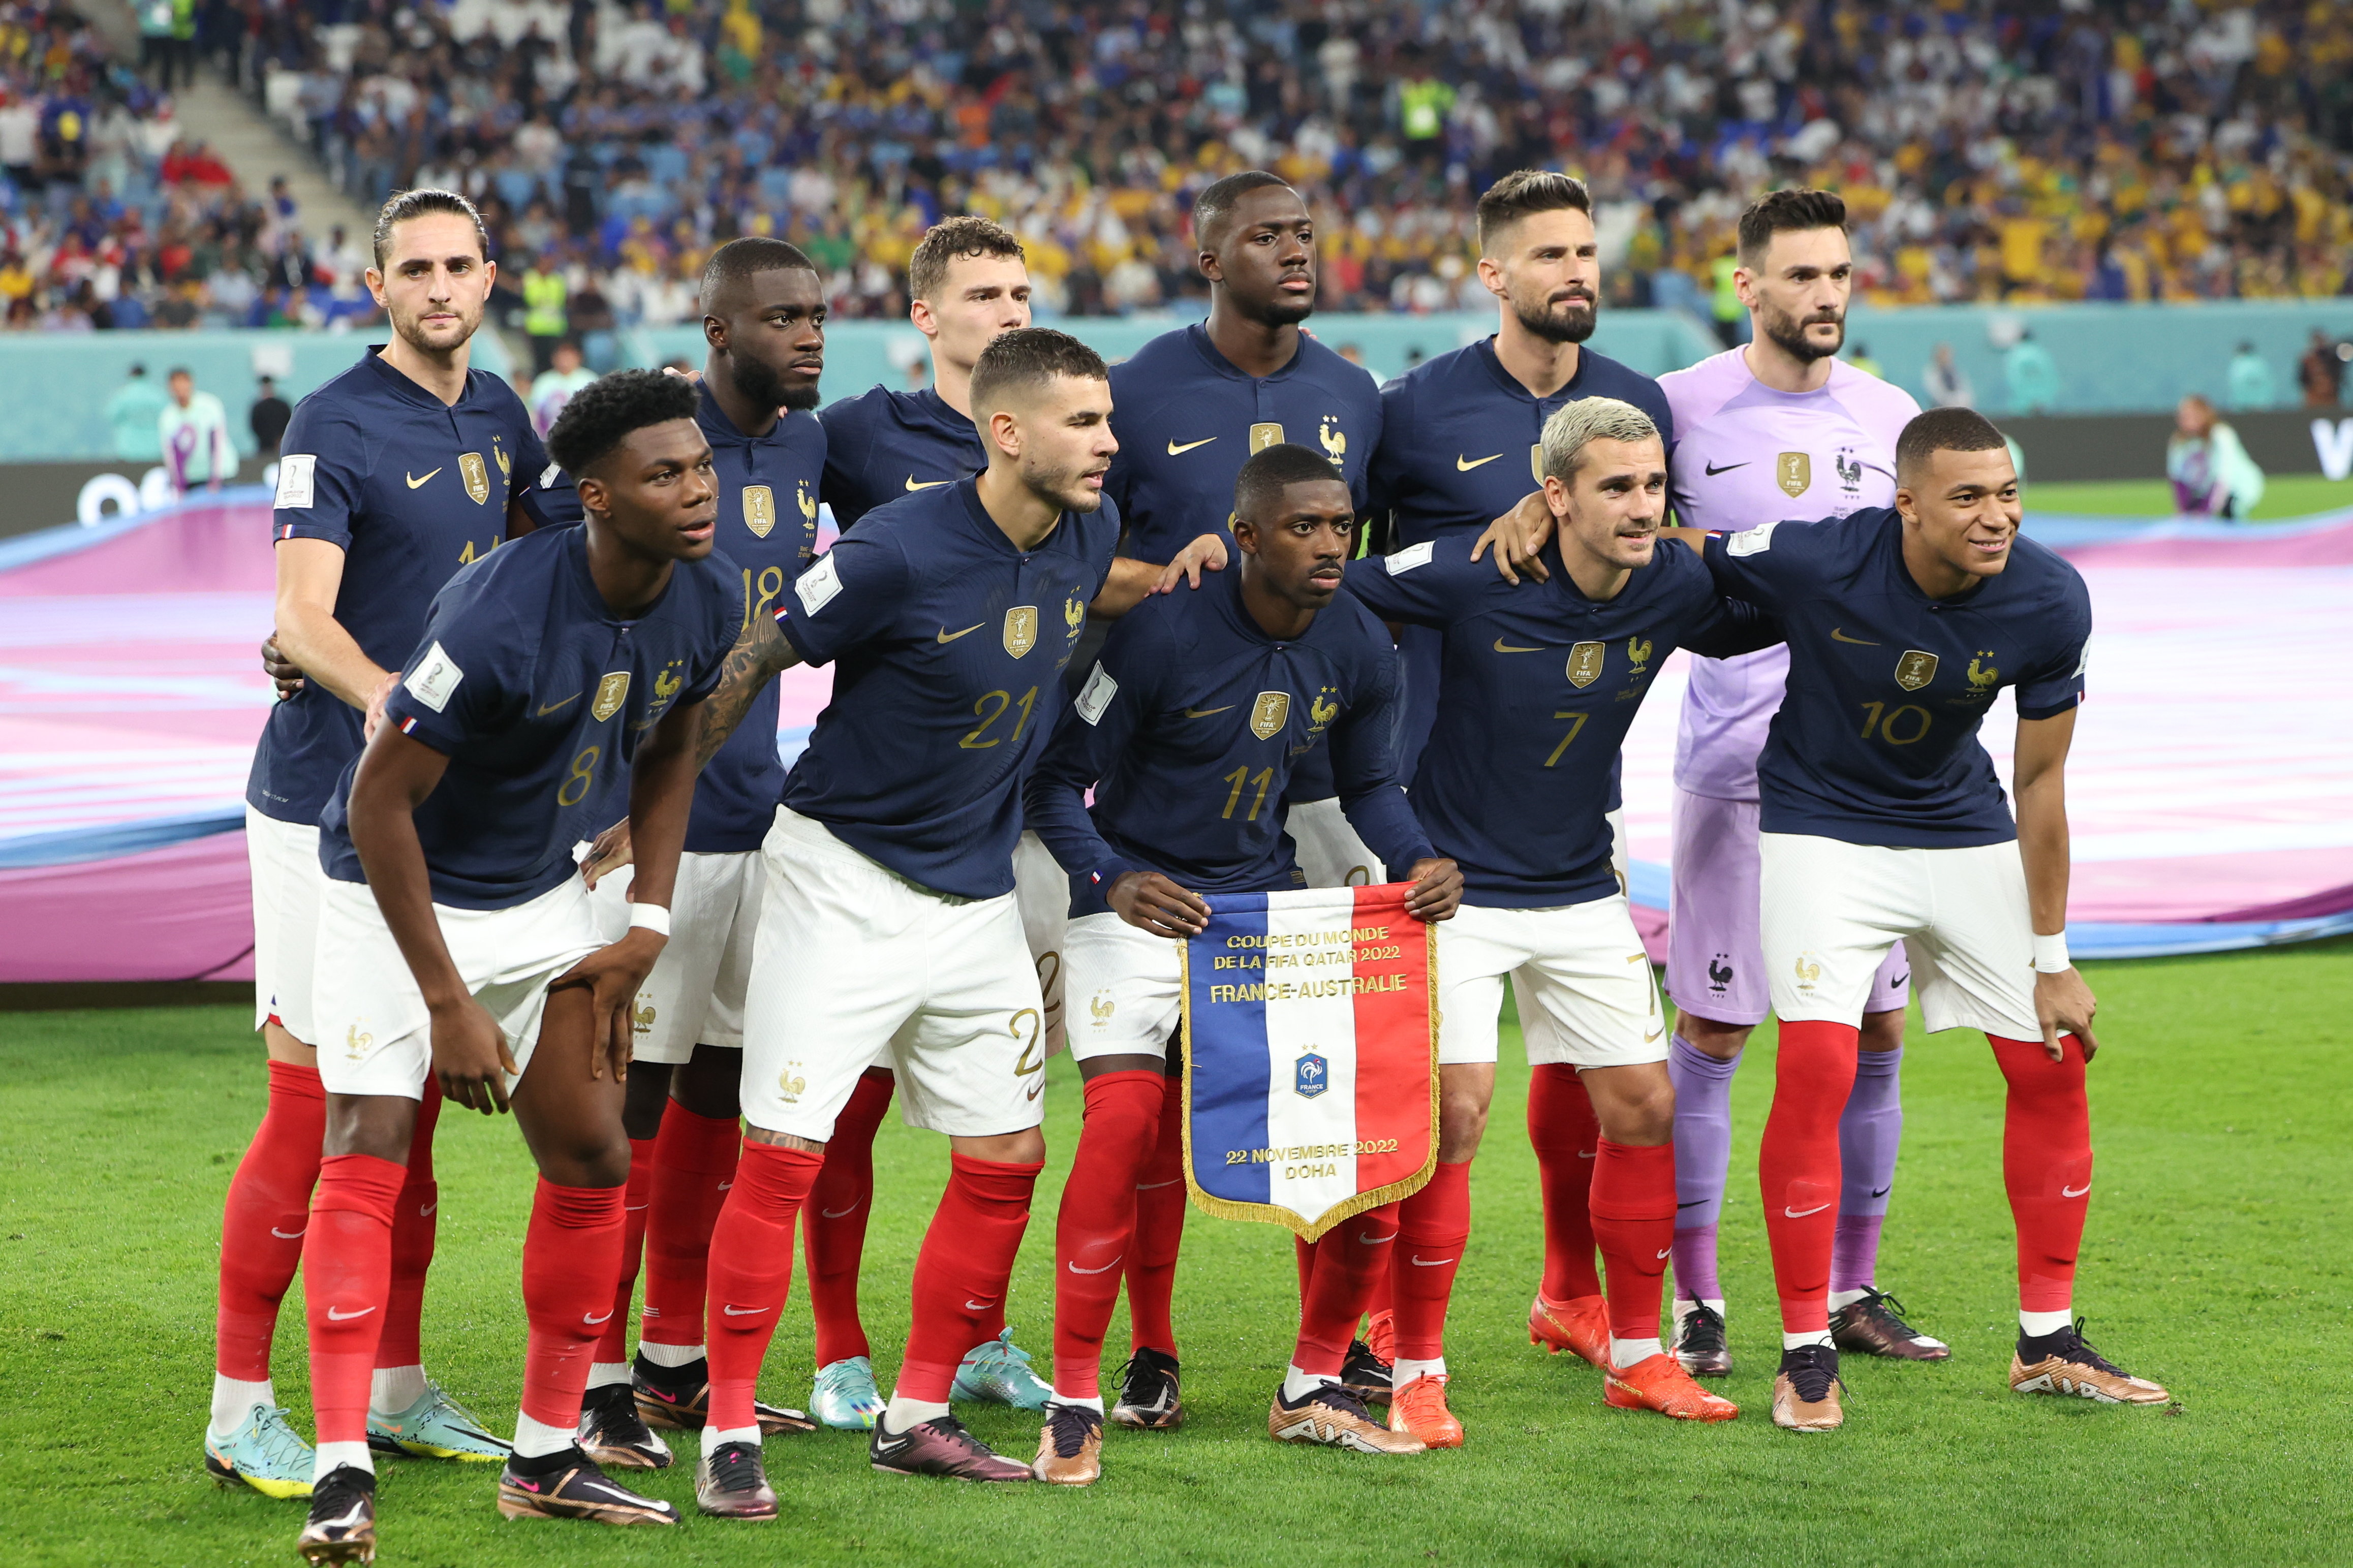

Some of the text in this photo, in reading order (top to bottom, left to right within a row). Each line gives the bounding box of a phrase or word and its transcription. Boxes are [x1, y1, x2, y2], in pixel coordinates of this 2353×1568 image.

[742, 566, 783, 632] 18
[958, 686, 1038, 749] 21
[1544, 711, 1589, 767] 7
[1861, 701, 1931, 745] 10
[558, 745, 600, 806] 8
[1222, 765, 1274, 821] 11
[1214, 946, 1401, 970] DE LA FIFA QATAR 2022
[1226, 926, 1389, 949] COUPE DU MONDE
[1210, 974, 1407, 1003] FRANCE-AUSTRALIE
[1626, 952, 1655, 1016] 7
[1009, 1008, 1043, 1077] 2
[1226, 1139, 1398, 1166] 22 NOVEMBRE 2022
[1285, 1164, 1337, 1179] DOHA
